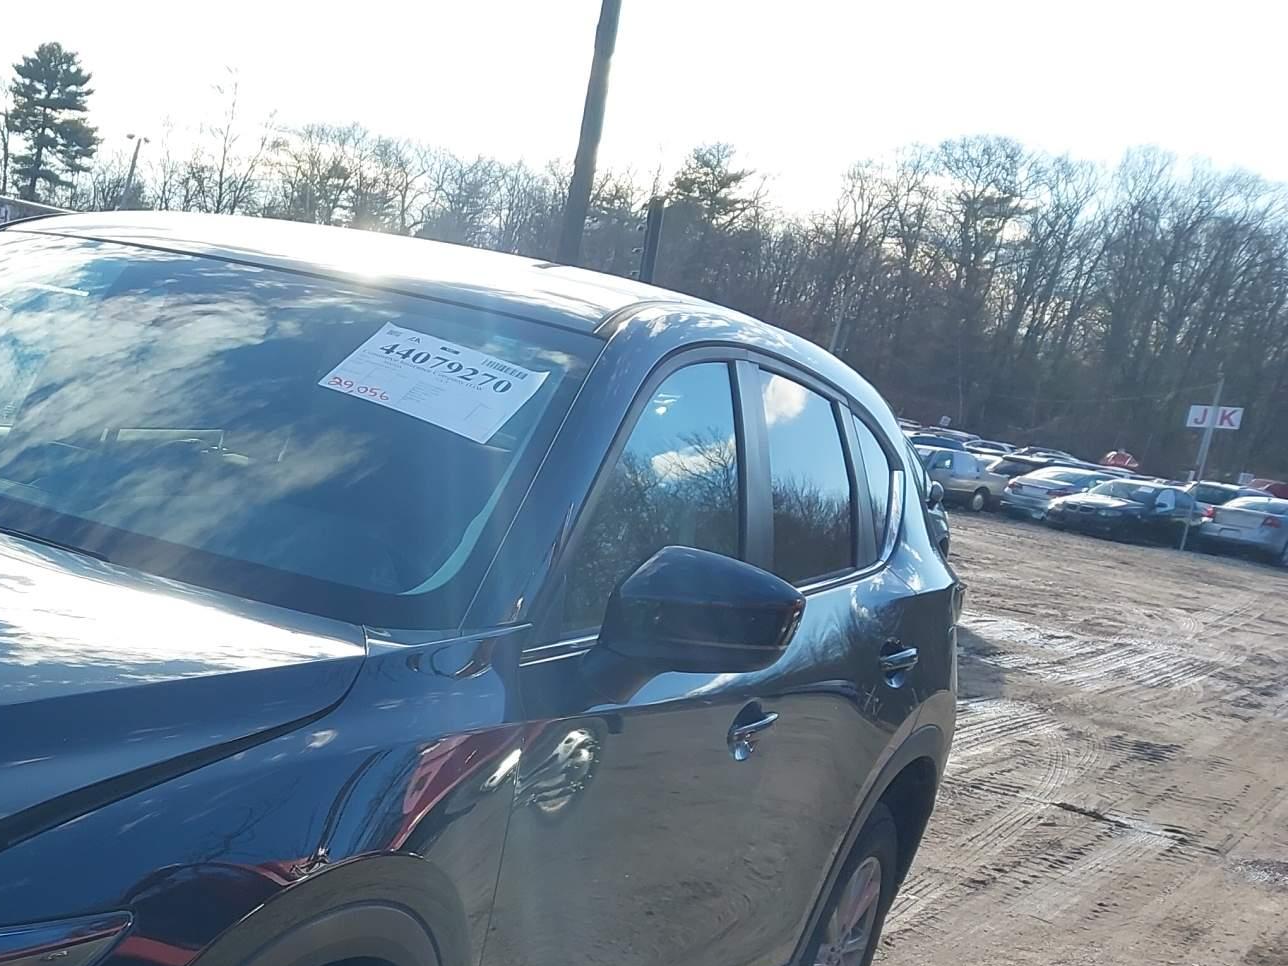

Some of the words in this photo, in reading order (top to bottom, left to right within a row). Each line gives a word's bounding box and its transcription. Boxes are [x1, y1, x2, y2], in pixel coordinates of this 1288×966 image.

[379, 342, 512, 393] 44079270
[328, 376, 390, 401] 29,056
[1193, 408, 1208, 424] J
[1219, 409, 1238, 426] K
